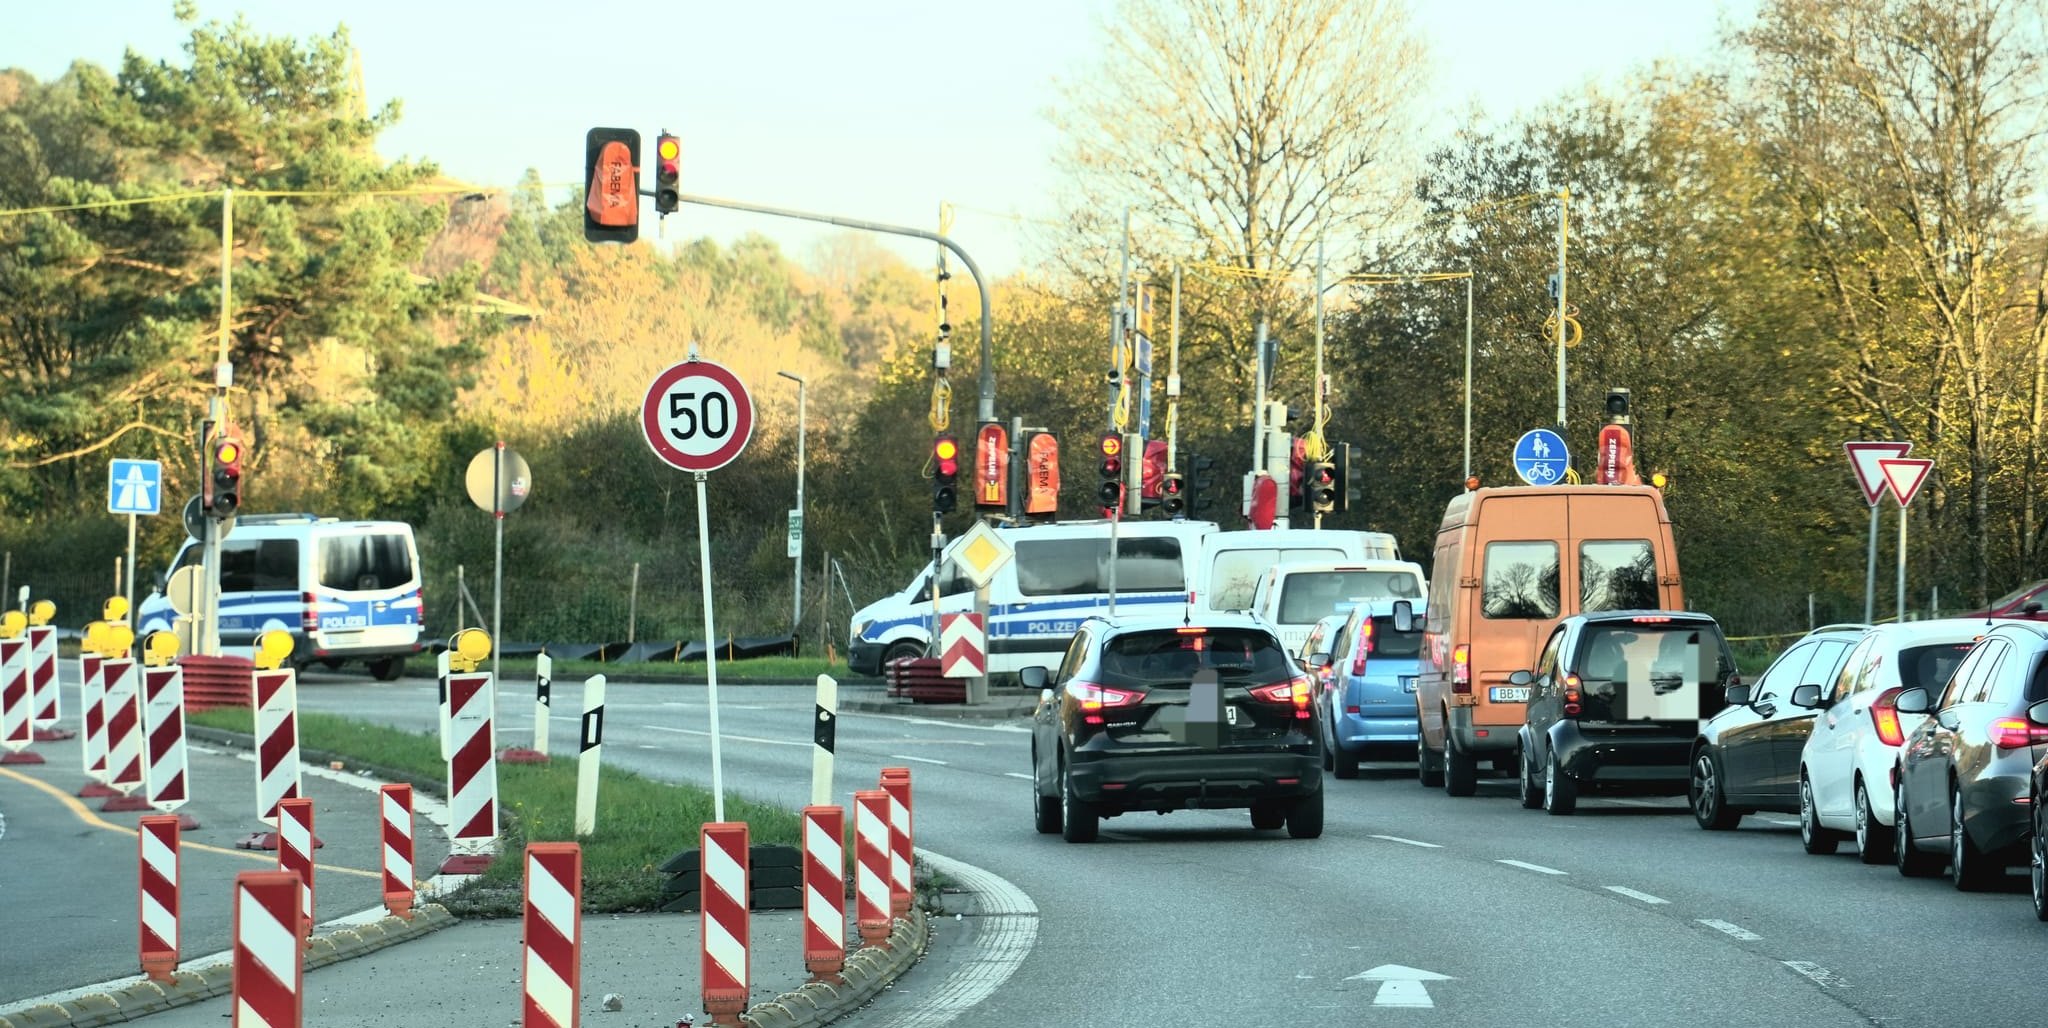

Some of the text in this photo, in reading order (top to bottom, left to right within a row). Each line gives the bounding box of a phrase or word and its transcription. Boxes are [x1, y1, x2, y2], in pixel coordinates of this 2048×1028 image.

[610, 160, 621, 208] FABEMA
[669, 391, 728, 440] 50
[1607, 438, 1617, 478] ZEPPELIN
[322, 615, 366, 628] POLIZEI
[1028, 621, 1076, 633] POLIZEI
[1500, 688, 1513, 699] BB
